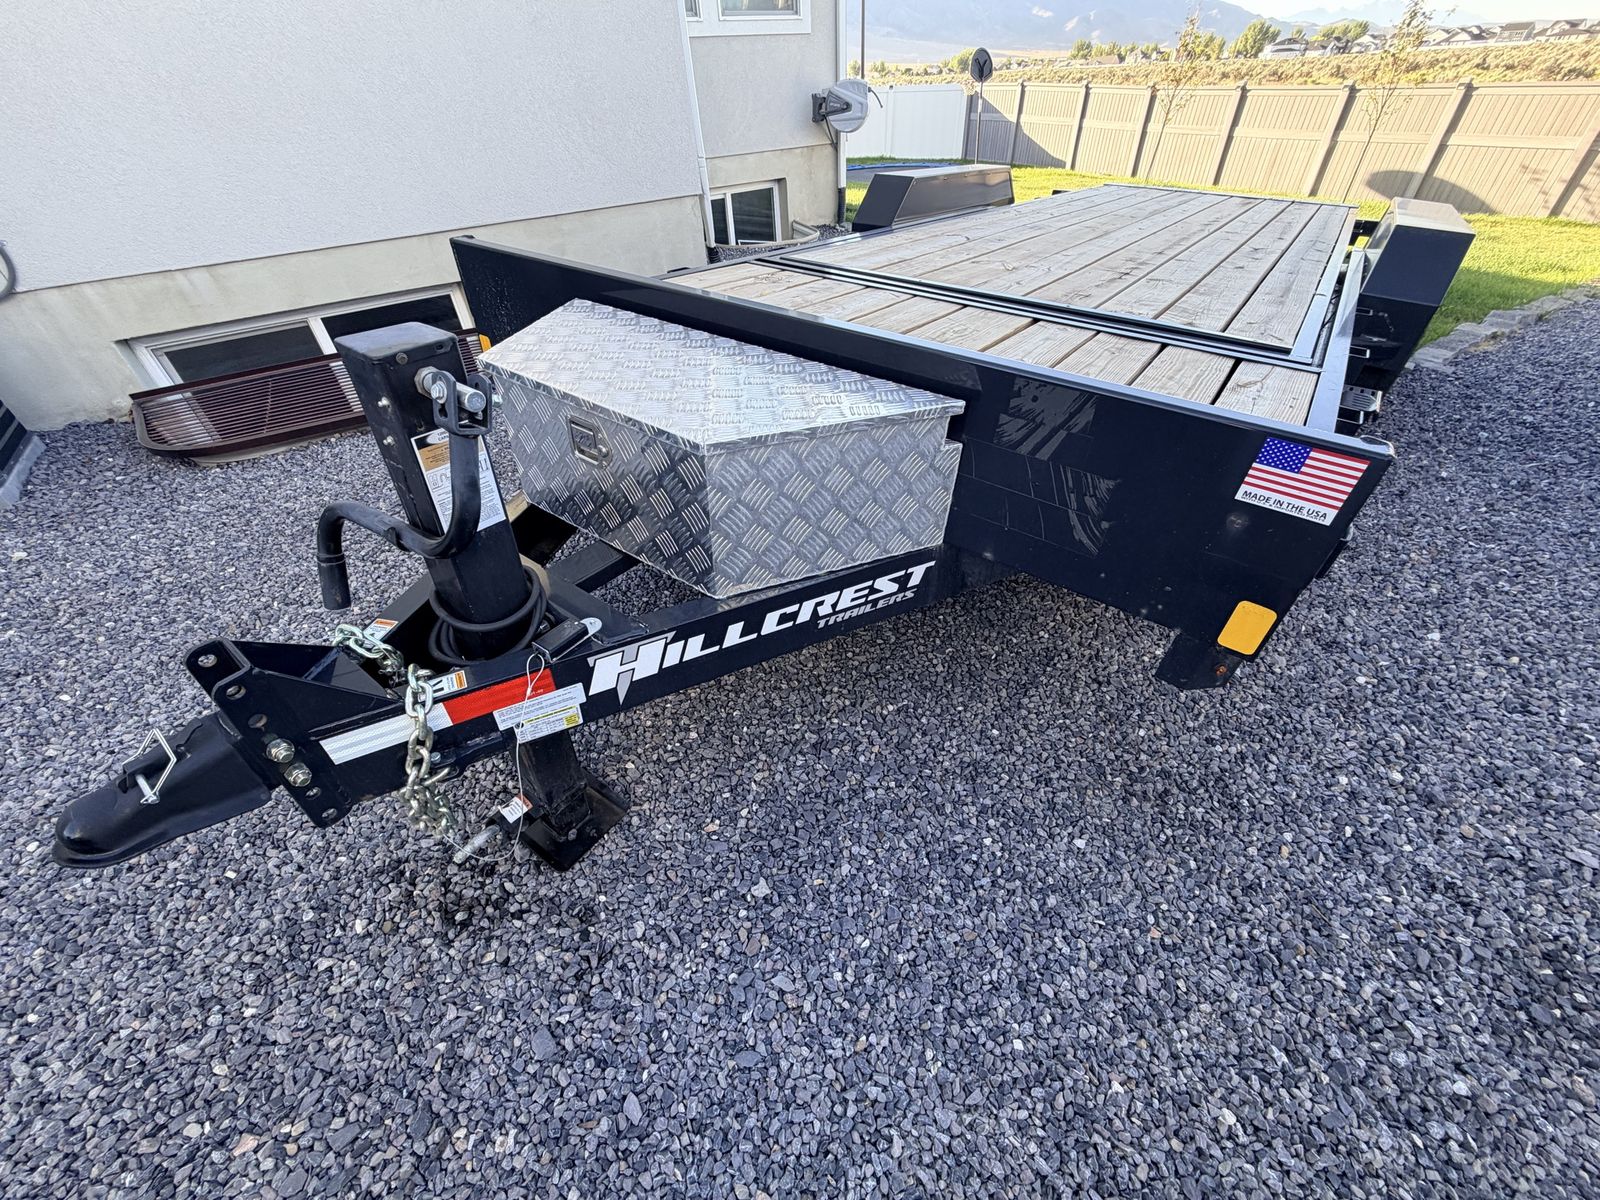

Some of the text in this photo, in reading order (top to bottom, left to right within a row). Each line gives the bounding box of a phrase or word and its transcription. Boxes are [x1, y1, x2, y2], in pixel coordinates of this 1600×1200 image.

[1242, 490, 1328, 520] MADE IN THE USA
[816, 588, 916, 630] TRAILERS
[587, 561, 936, 704] HILLCREST
